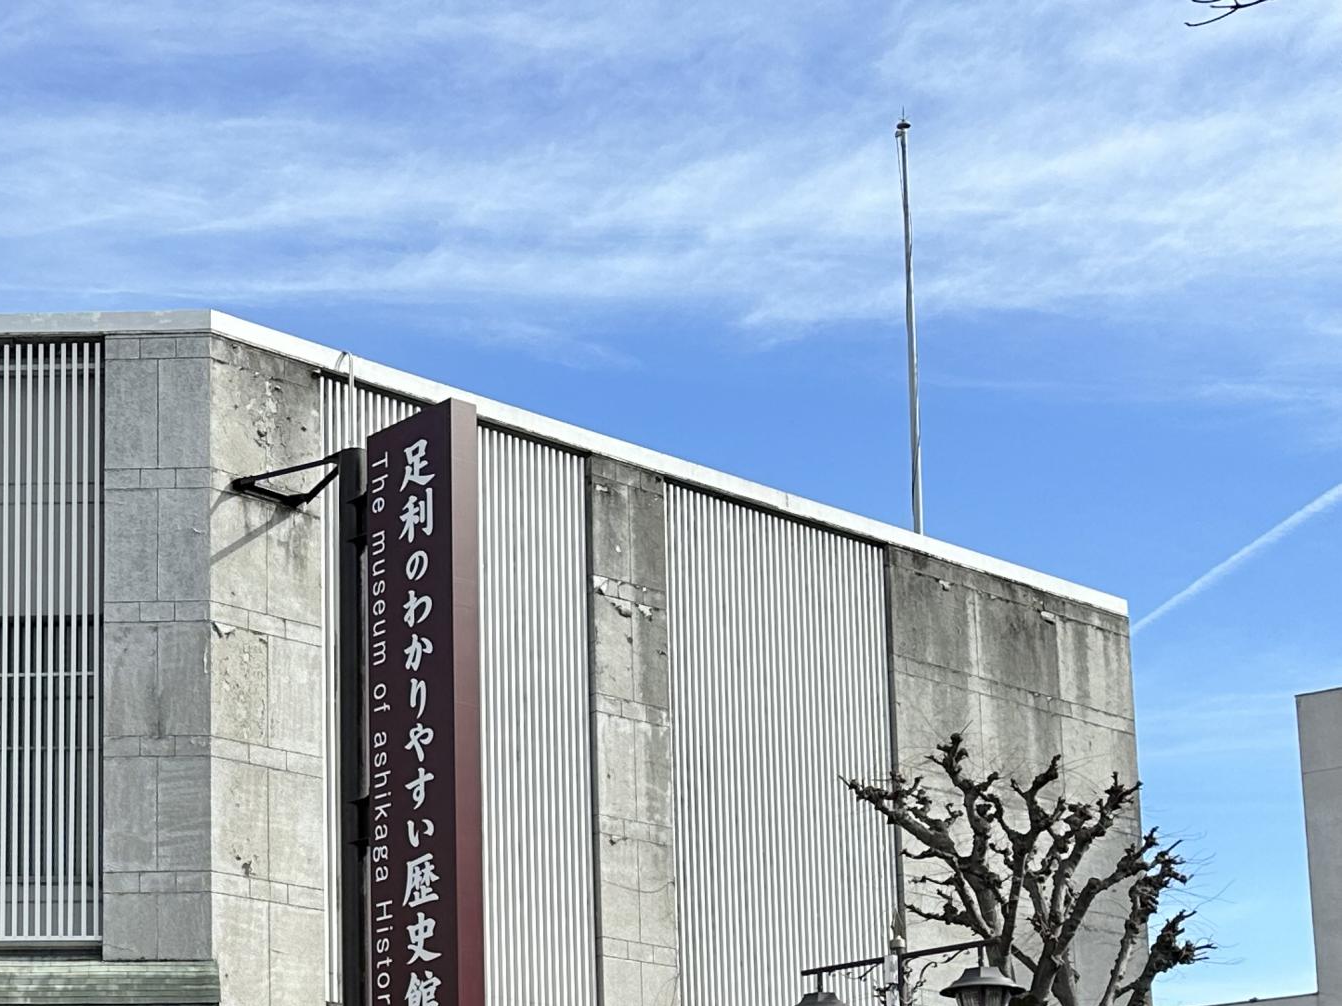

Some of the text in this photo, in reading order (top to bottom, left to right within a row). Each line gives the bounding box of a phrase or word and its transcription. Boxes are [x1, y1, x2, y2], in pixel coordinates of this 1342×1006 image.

[371, 451, 389, 514] The
[371, 530, 388, 667] museum
[372, 682, 390, 713] of
[372, 731, 393, 882] ashikaga
